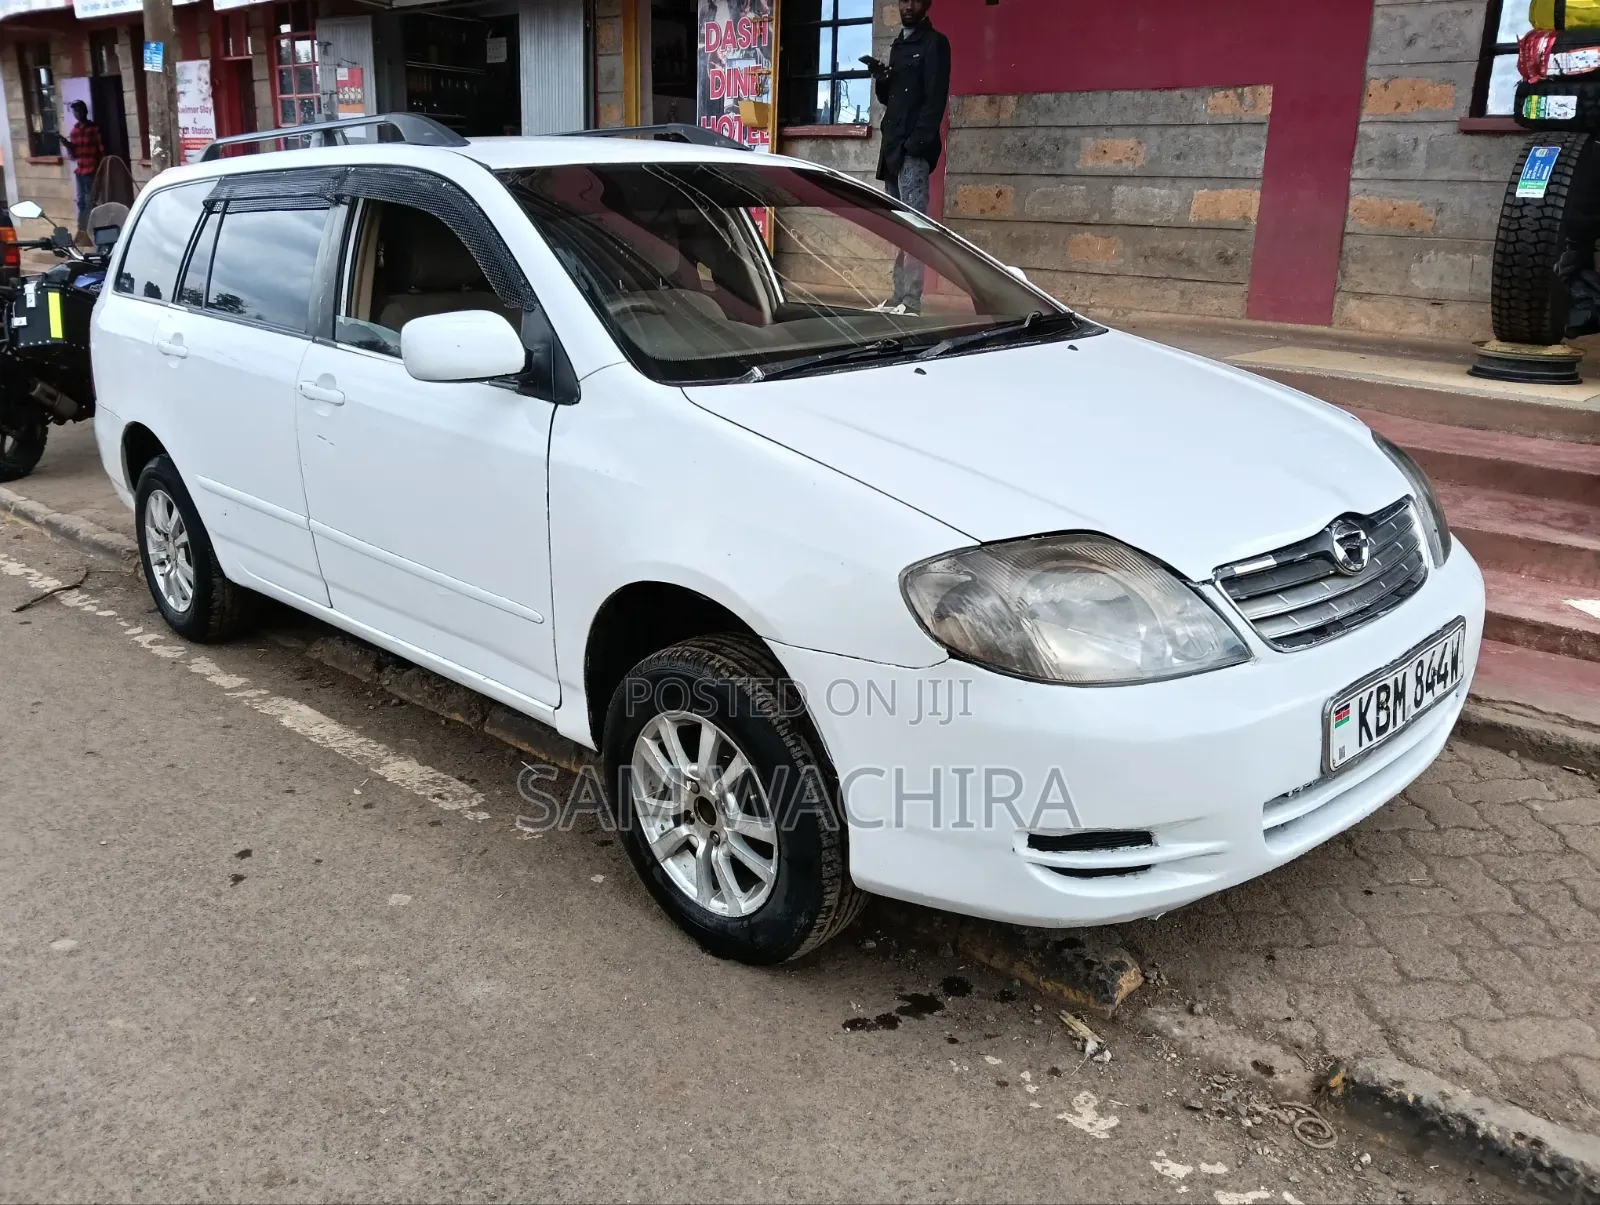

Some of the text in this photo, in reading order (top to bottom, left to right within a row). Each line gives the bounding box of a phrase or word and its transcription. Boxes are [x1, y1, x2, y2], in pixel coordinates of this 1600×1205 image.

[704, 15, 769, 53] DASH
[709, 64, 763, 100] DINE
[1358, 632, 1460, 748] KBM 844W
